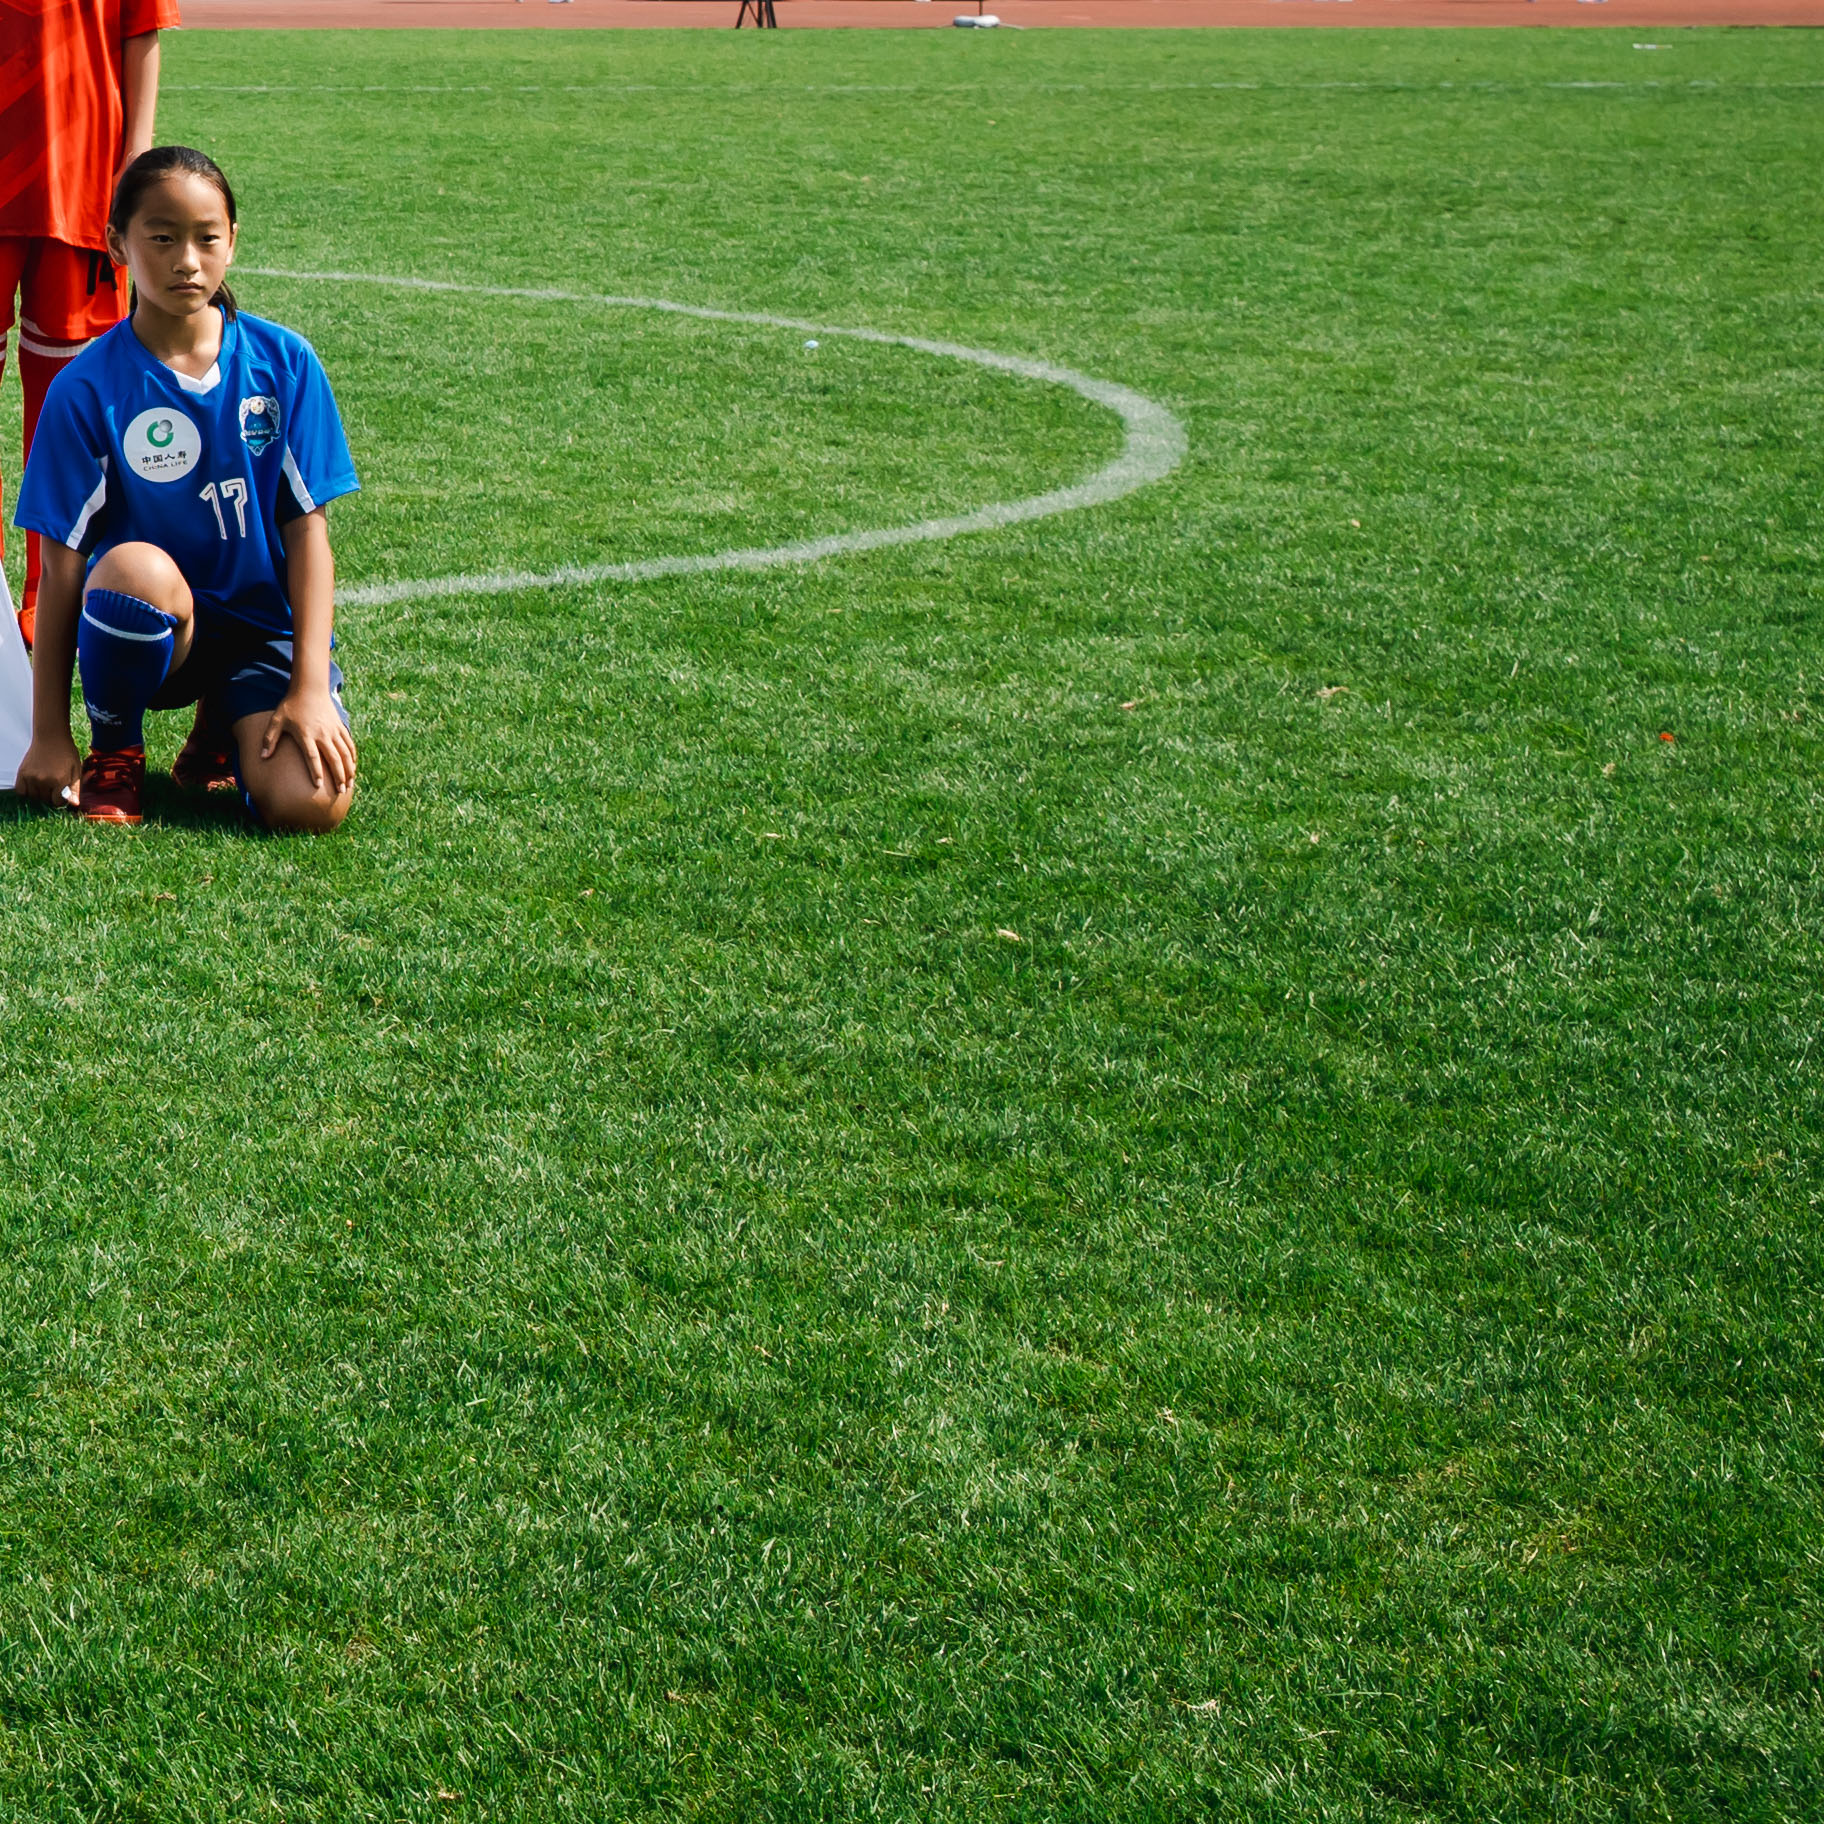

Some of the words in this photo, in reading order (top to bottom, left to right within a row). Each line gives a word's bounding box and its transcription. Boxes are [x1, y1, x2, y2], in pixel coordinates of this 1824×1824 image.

[141, 450, 188, 466] 中国人寿
[143, 463, 169, 472] CHINA
[170, 460, 188, 468] LIFE
[199, 477, 249, 540] 17
